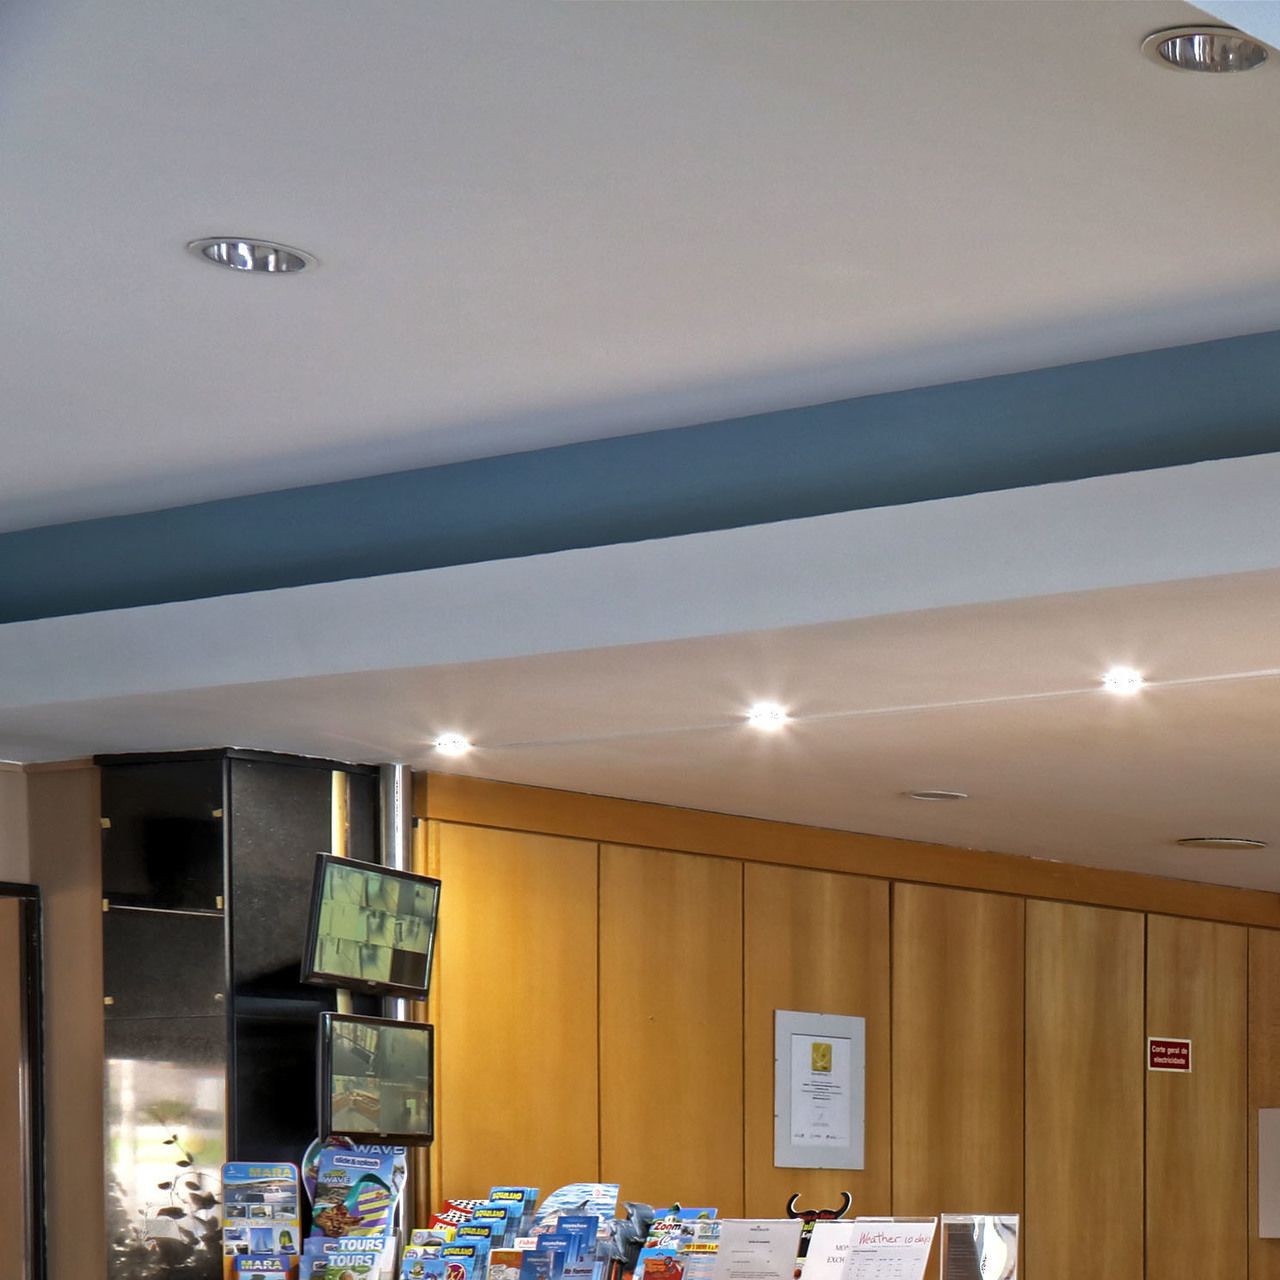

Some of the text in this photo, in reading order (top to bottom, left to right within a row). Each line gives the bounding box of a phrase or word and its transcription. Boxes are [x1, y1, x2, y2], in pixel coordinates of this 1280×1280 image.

[352, 1145, 407, 1156] WAVE
[248, 1167, 293, 1178] MARA
[323, 1176, 351, 1184] WAVE
[654, 1222, 682, 1231] Zoom
[858, 1231, 899, 1245] Weather
[339, 1239, 386, 1251] TOURS
[240, 1260, 283, 1270] MARA
[328, 1256, 374, 1267] TOURS
